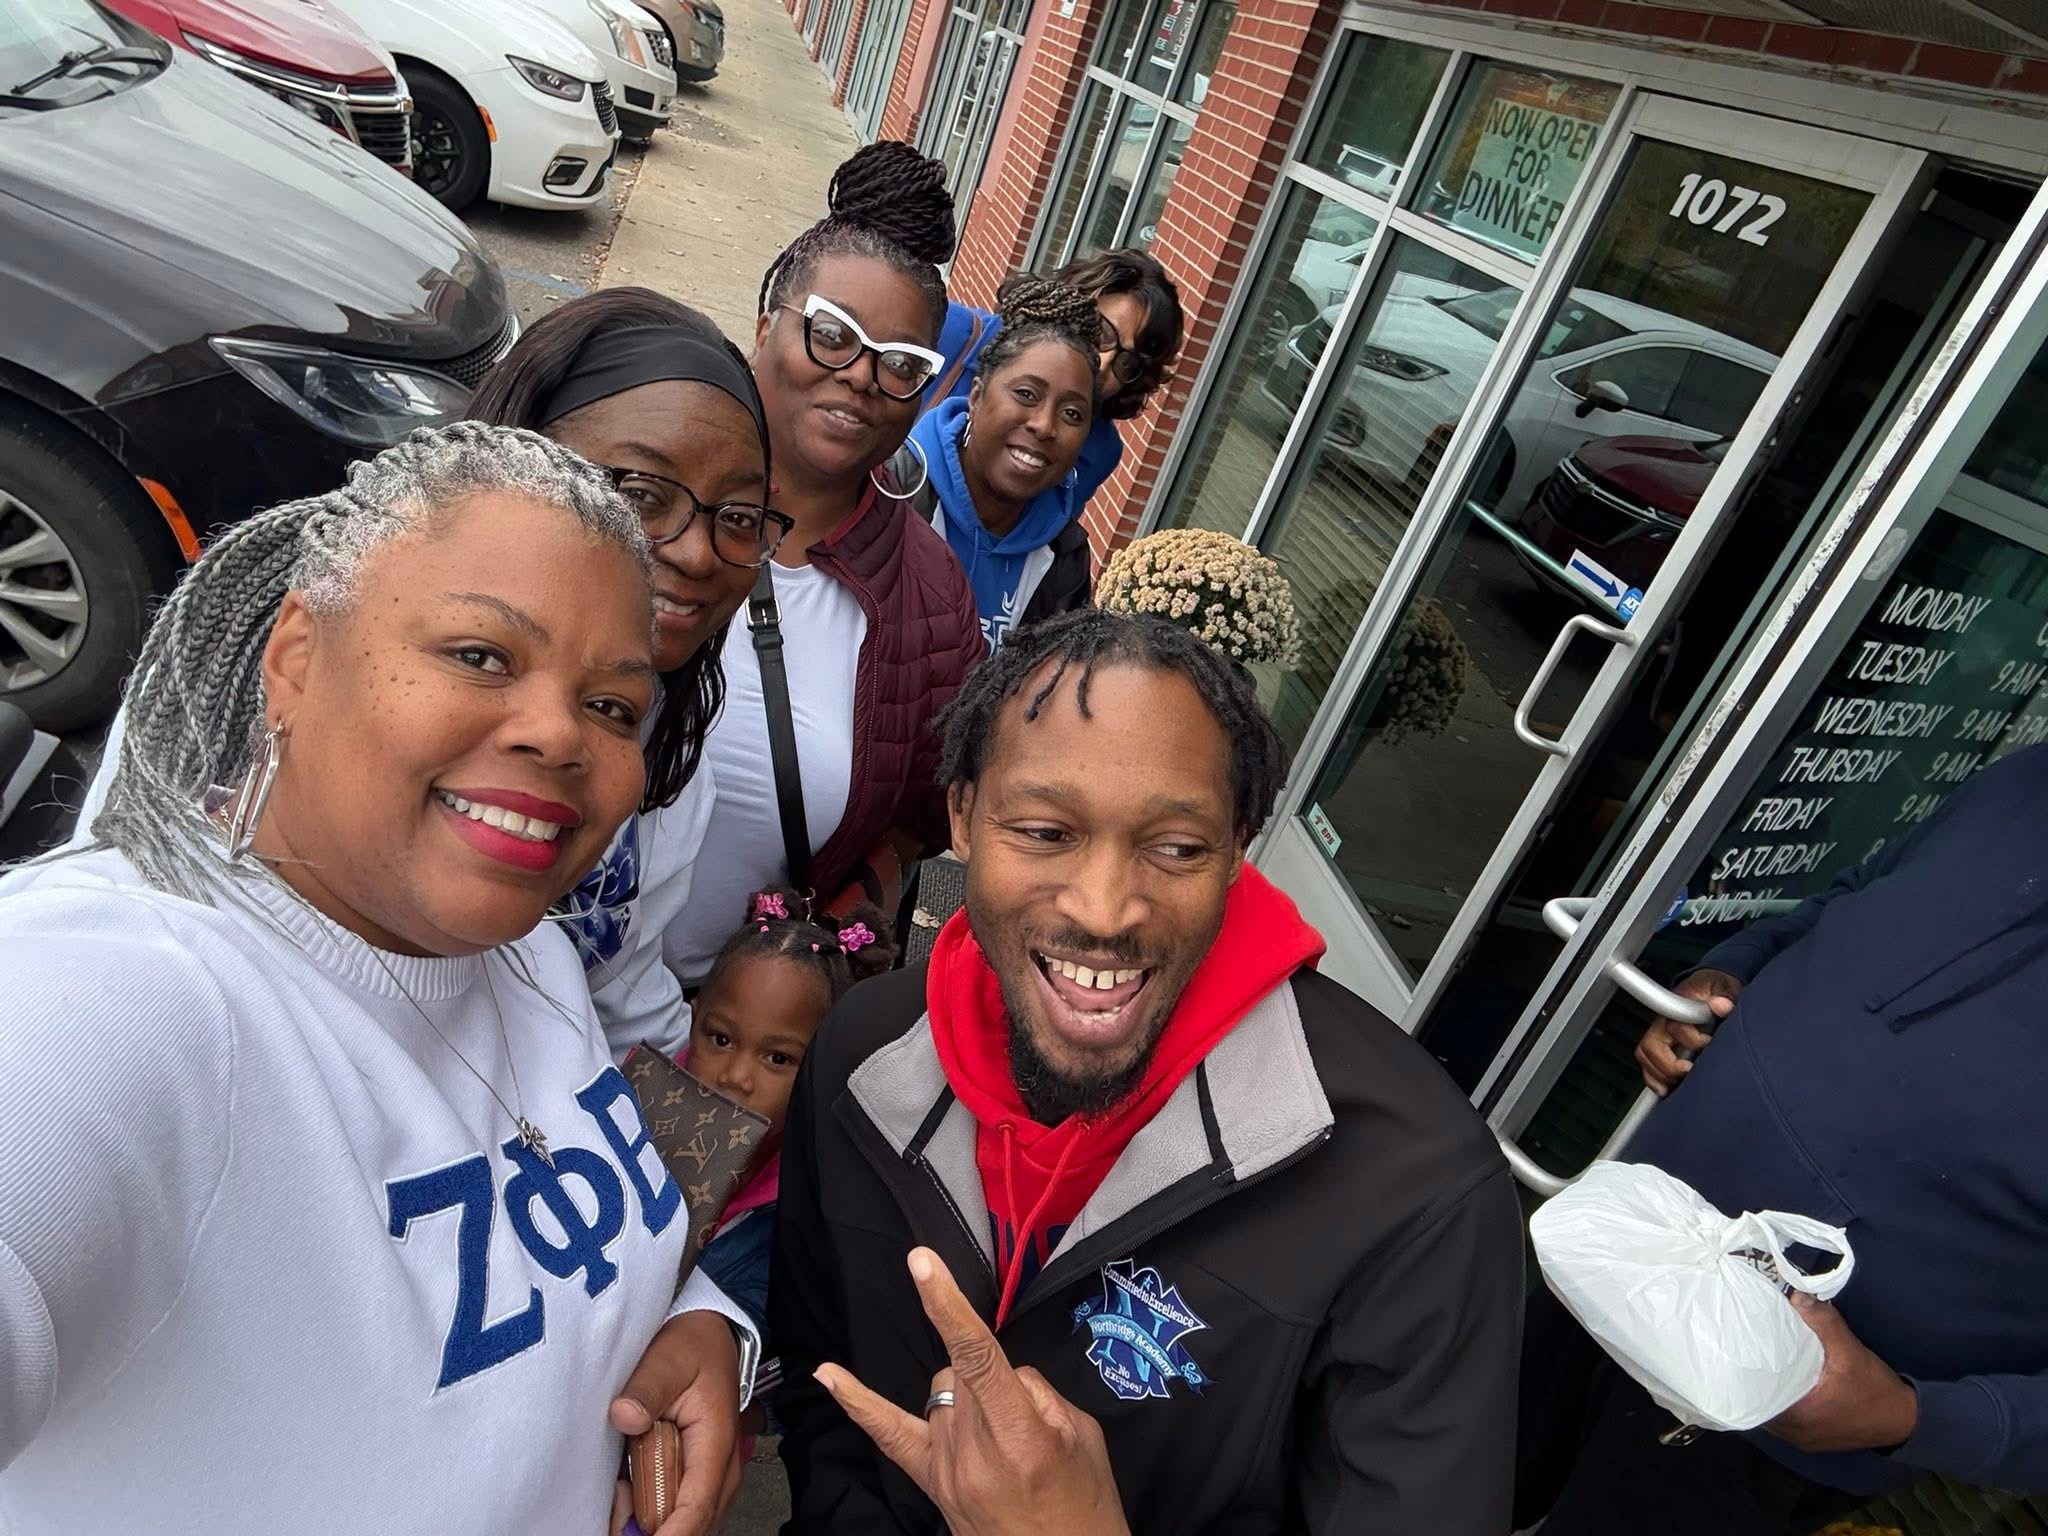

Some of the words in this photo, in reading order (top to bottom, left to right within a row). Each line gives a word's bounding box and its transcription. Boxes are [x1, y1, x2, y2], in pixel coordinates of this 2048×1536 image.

[1488, 100, 1541, 142] NOW
[1505, 147, 1551, 186] FOR
[1461, 171, 1565, 244] DINNER
[1669, 173, 1787, 246] 1072
[1880, 584, 1992, 633] MONDAY
[1847, 640, 1955, 685] TUESDAY
[1812, 697, 1954, 739] WEDNESDAY
[1779, 747, 1902, 782] THURSDAY
[1741, 797, 1833, 833] FRIDAY
[1712, 841, 1838, 881] SATURDAY
[1681, 888, 1783, 926] SUNDAY
[1104, 1263, 1143, 1300] Committed
[1148, 1293, 1195, 1328] Excellence
[1135, 1335, 1176, 1377] Academy
